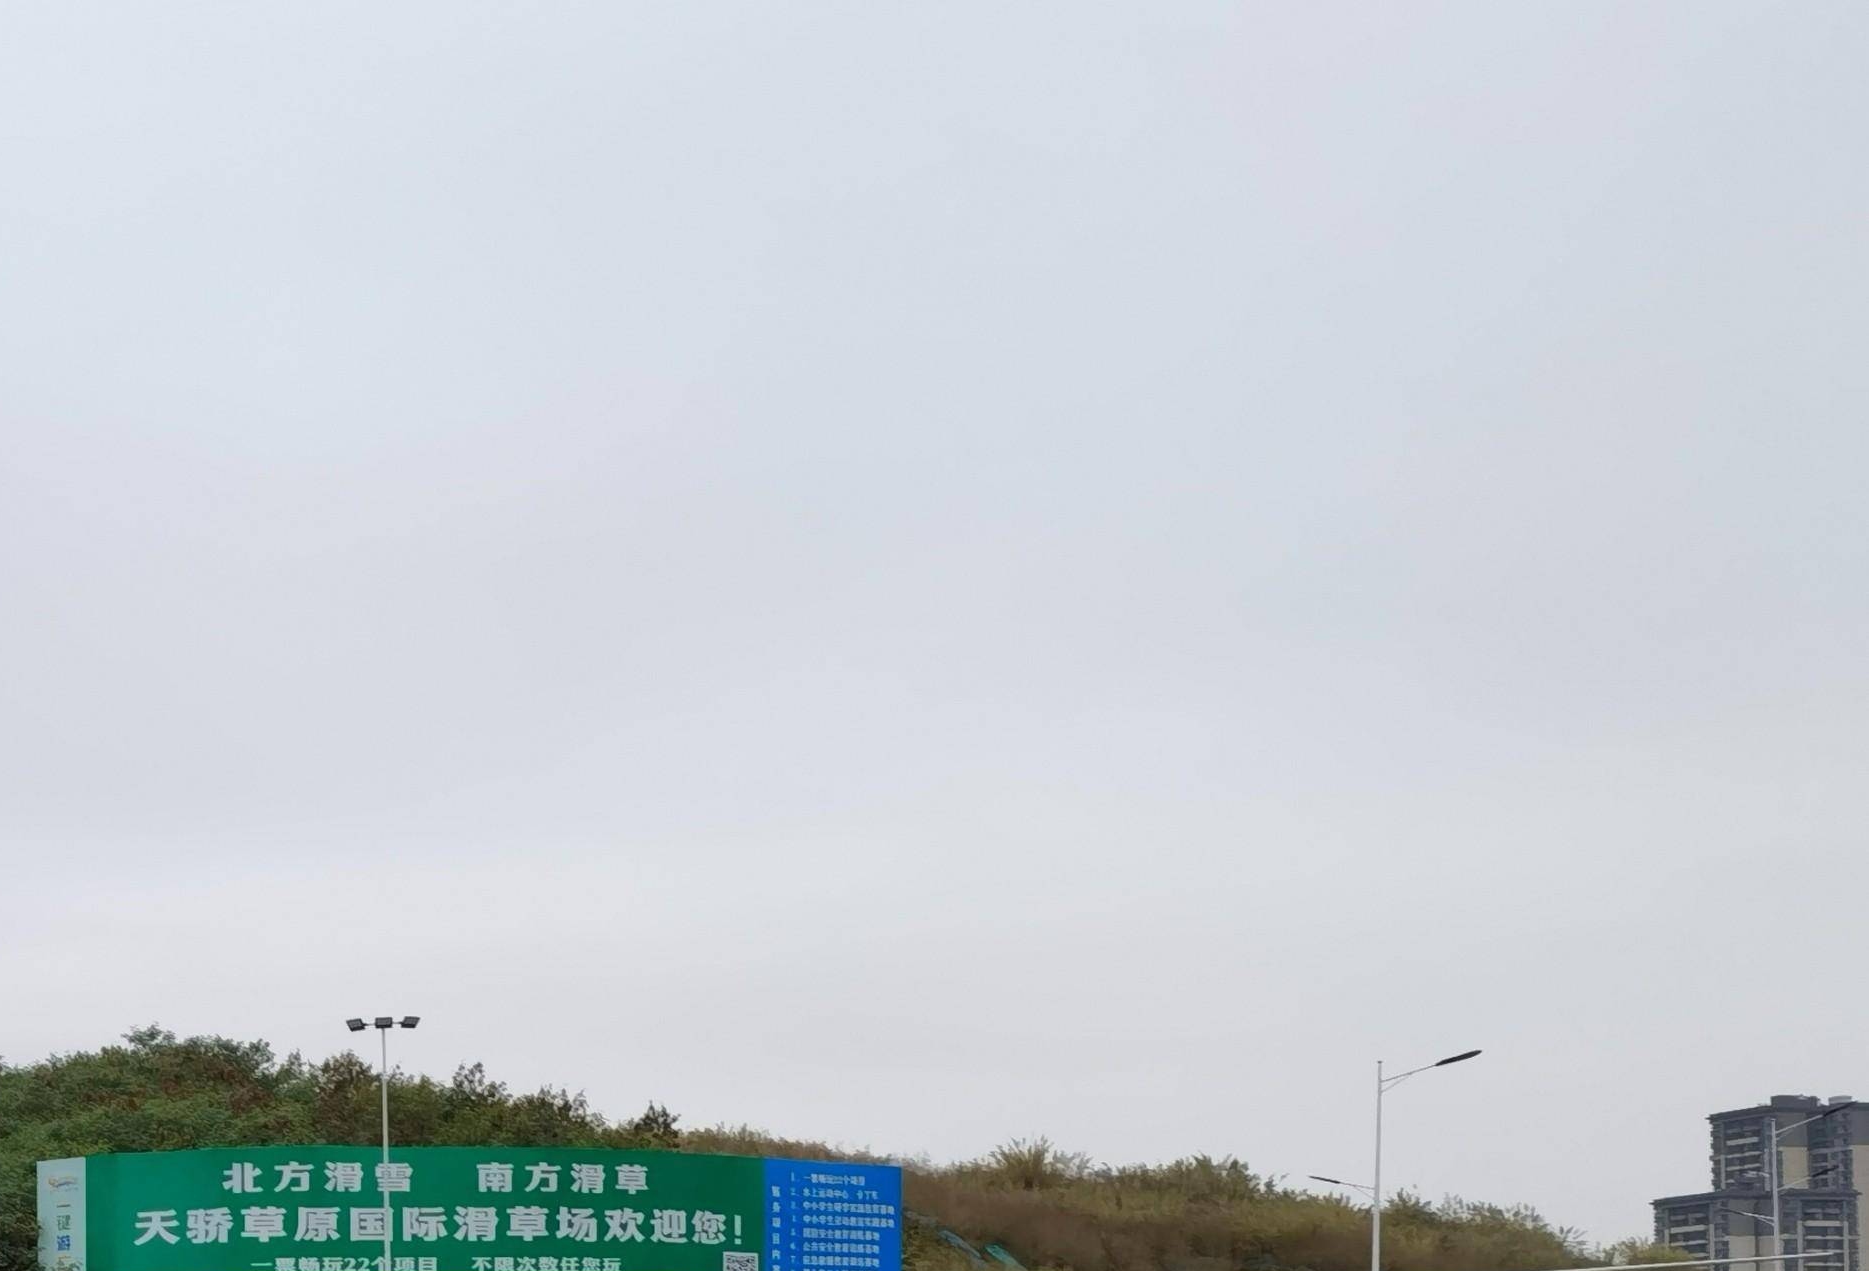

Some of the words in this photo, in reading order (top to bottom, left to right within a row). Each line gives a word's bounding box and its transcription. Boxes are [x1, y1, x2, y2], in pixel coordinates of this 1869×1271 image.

[223, 1161, 414, 1194] 北方滑雪
[476, 1161, 650, 1195] 南方滑草
